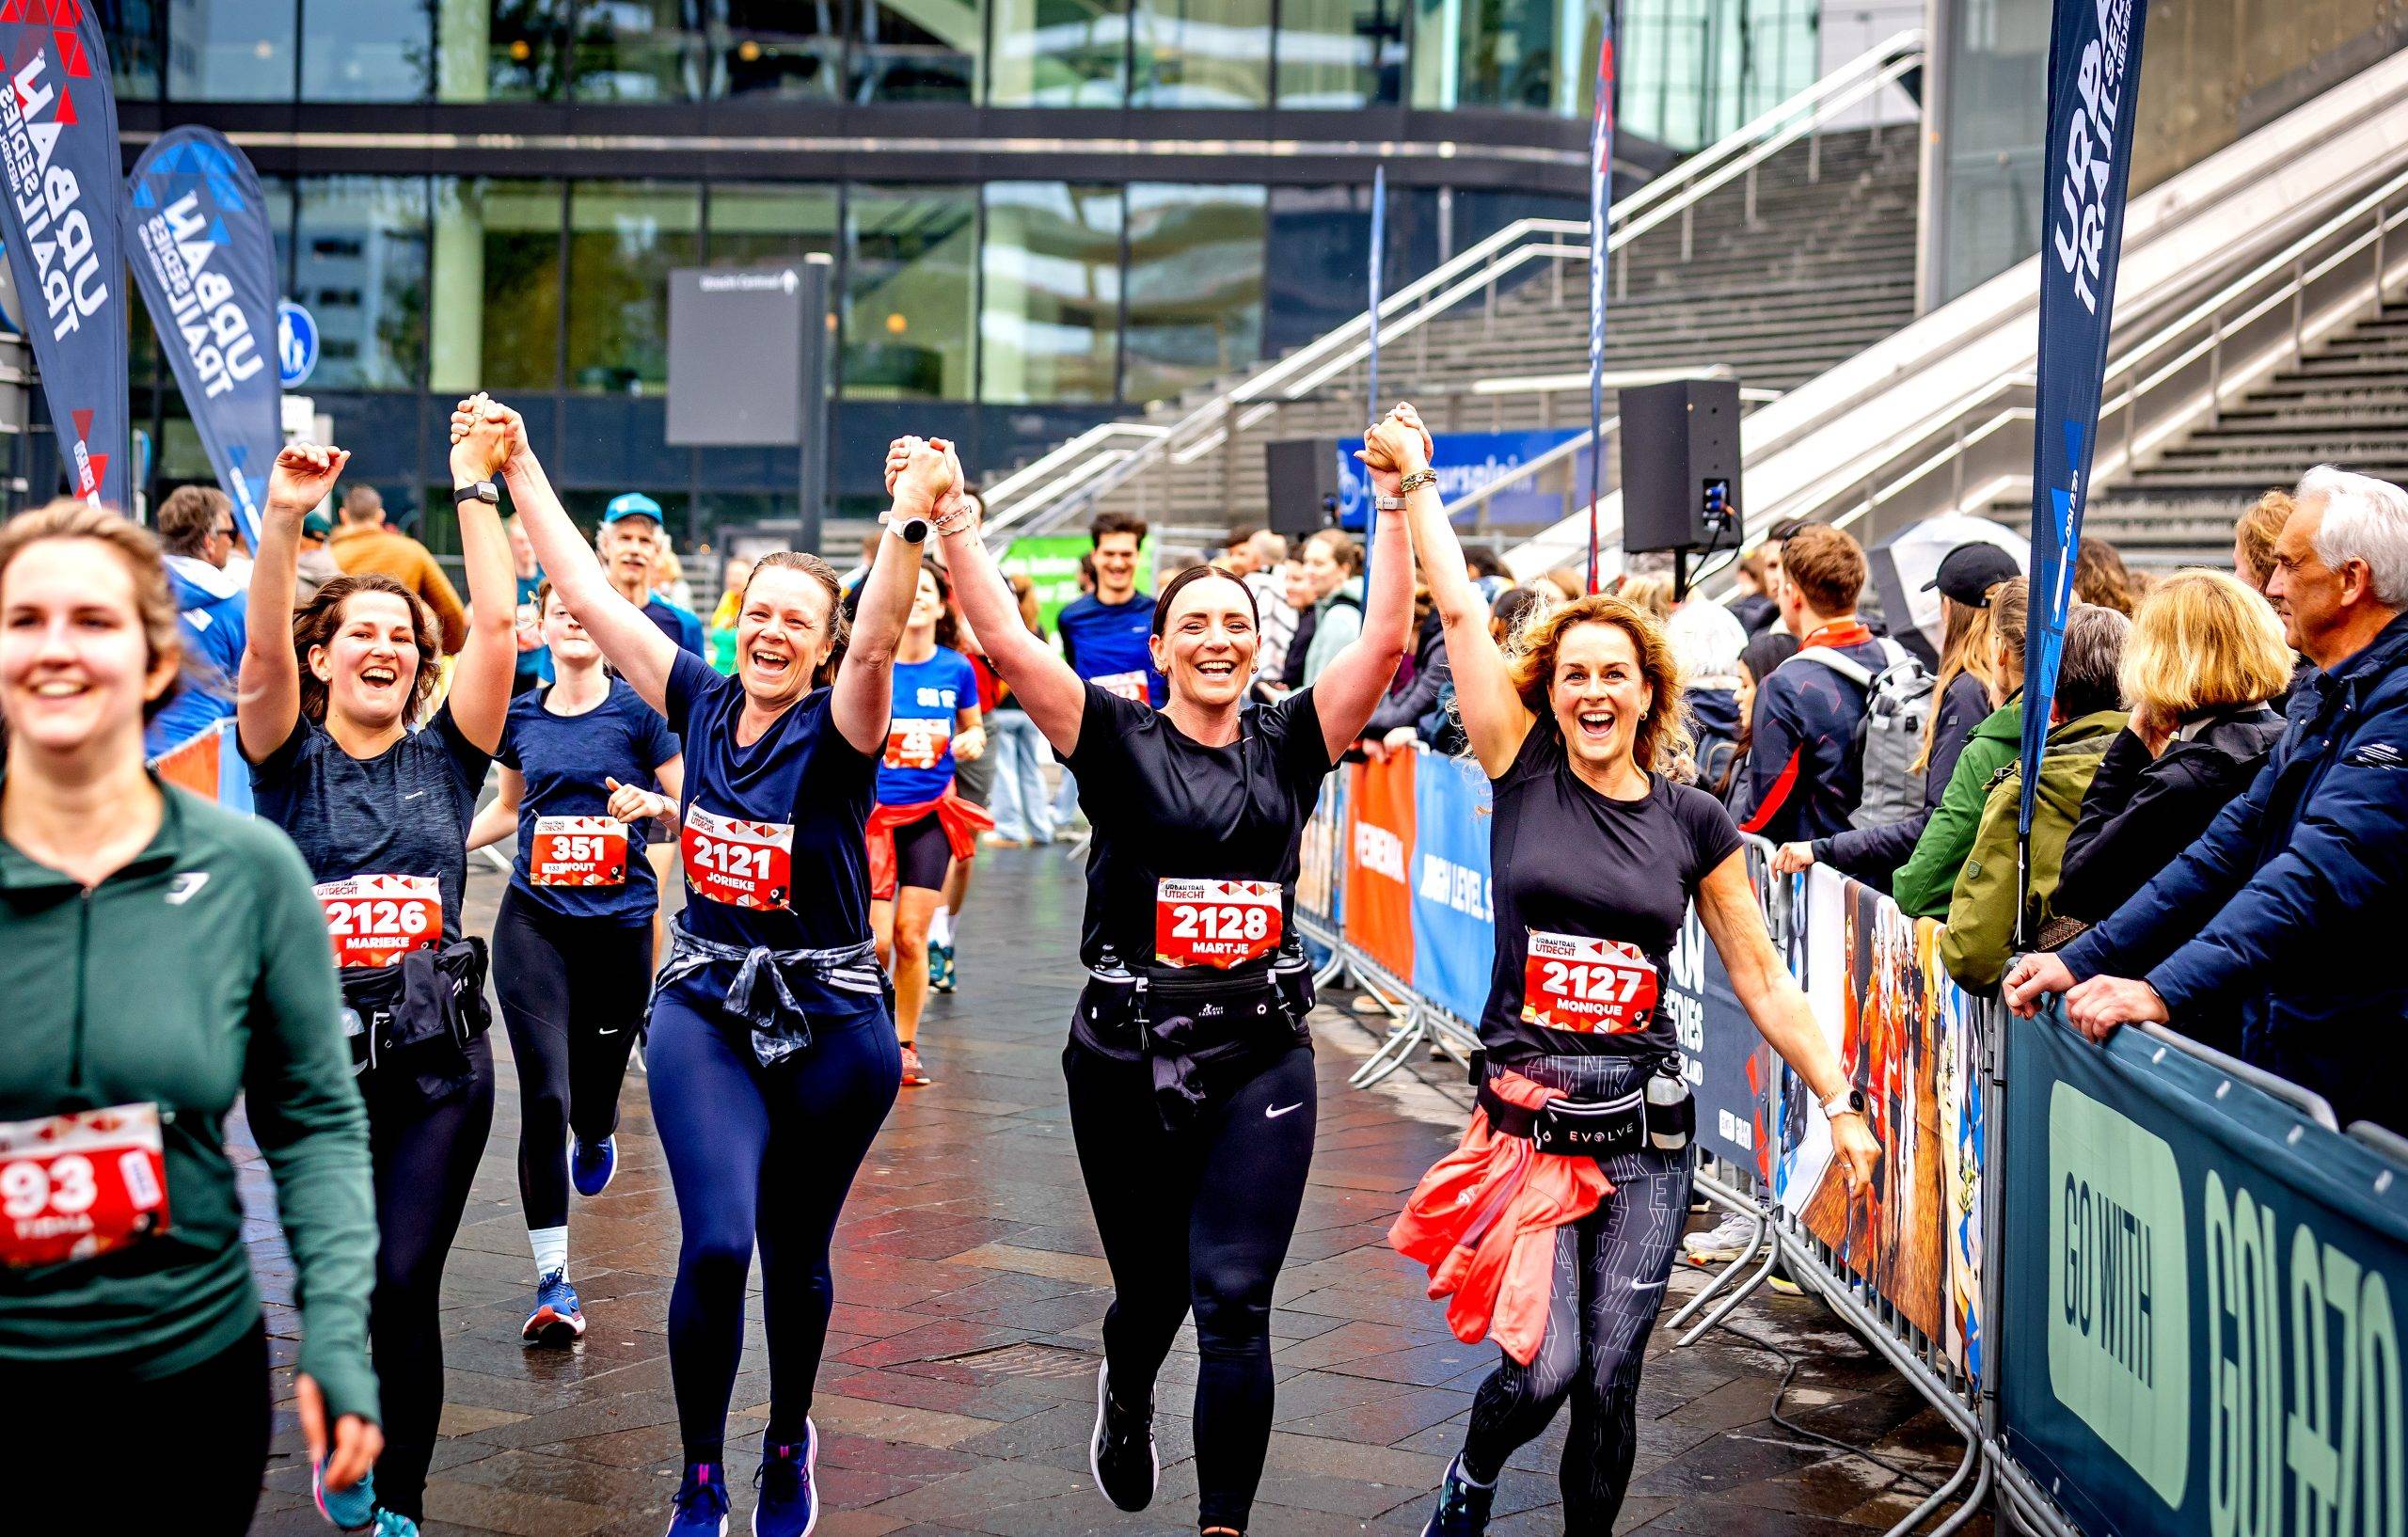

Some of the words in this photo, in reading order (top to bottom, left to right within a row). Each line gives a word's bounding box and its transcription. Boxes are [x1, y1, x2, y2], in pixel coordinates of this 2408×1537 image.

[2105, 0, 2125, 87] SER
[2117, 0, 2131, 82] NEDER
[2055, 0, 2108, 273] URBA
[2074, 82, 2120, 316] TRAIL
[551, 835, 605, 861] 351
[693, 835, 771, 879] 2121
[317, 886, 357, 896] UTRECHT
[706, 872, 755, 892] JORIEKE
[1165, 890, 1205, 898] UTRECHT
[325, 900, 428, 934] 2126
[1172, 905, 1268, 940] 2128
[346, 936, 409, 949] MARIEKE
[1193, 942, 1249, 954] MARTJE
[1535, 943, 1576, 956] UTRECHT
[1536, 937, 1558, 946] URBAN
[1558, 940, 1576, 948] TRAIL
[1543, 961, 1642, 1003] 2127
[1557, 998, 1623, 1016] MONIQUE
[1664, 988, 1703, 1053] ERIES
[1569, 1122, 1634, 1143] EVOLVE
[0, 1153, 99, 1219] 93
[2064, 1171, 2092, 1337] GO
[2097, 1191, 2152, 1390] WITH
[2204, 1169, 2405, 1537] GOLAZO
